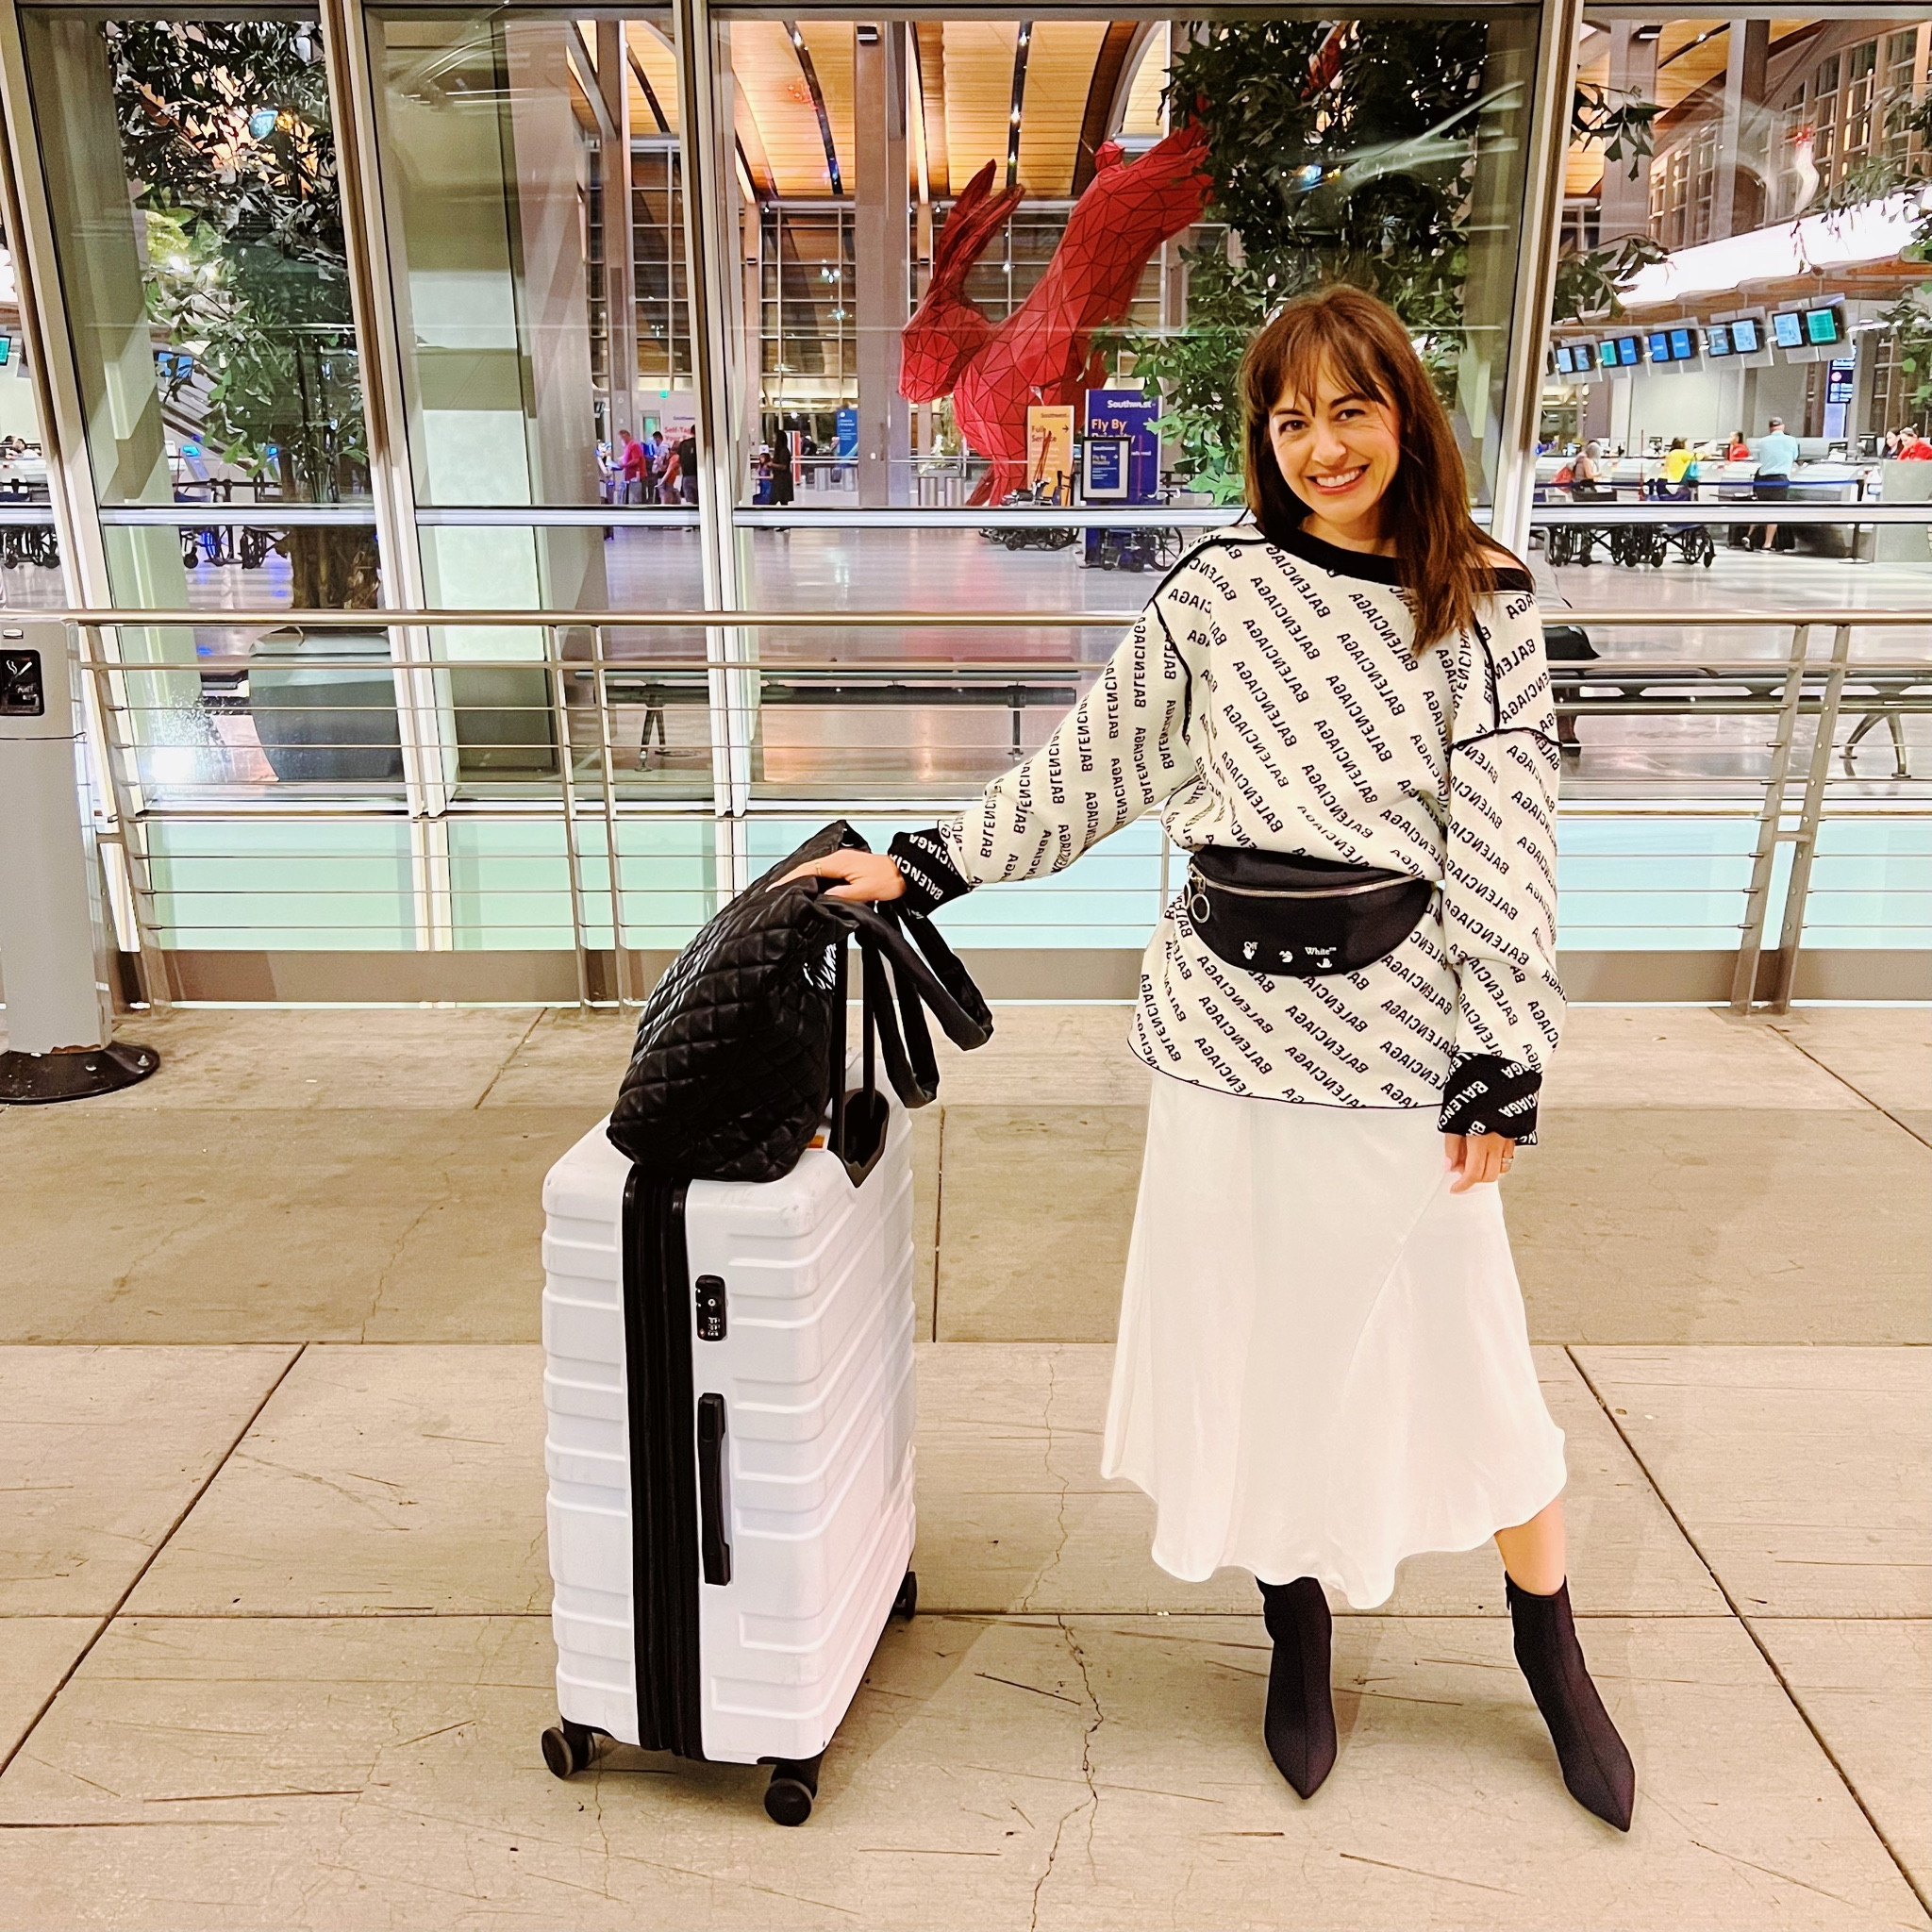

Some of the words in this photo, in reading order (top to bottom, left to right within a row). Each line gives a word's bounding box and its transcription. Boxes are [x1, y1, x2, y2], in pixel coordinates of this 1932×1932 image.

[1091, 419, 1108, 433] Fly
[1111, 419, 1127, 432] By
[890, 854, 943, 900] BALENCI
[1438, 1081, 1490, 1130] BALENC
